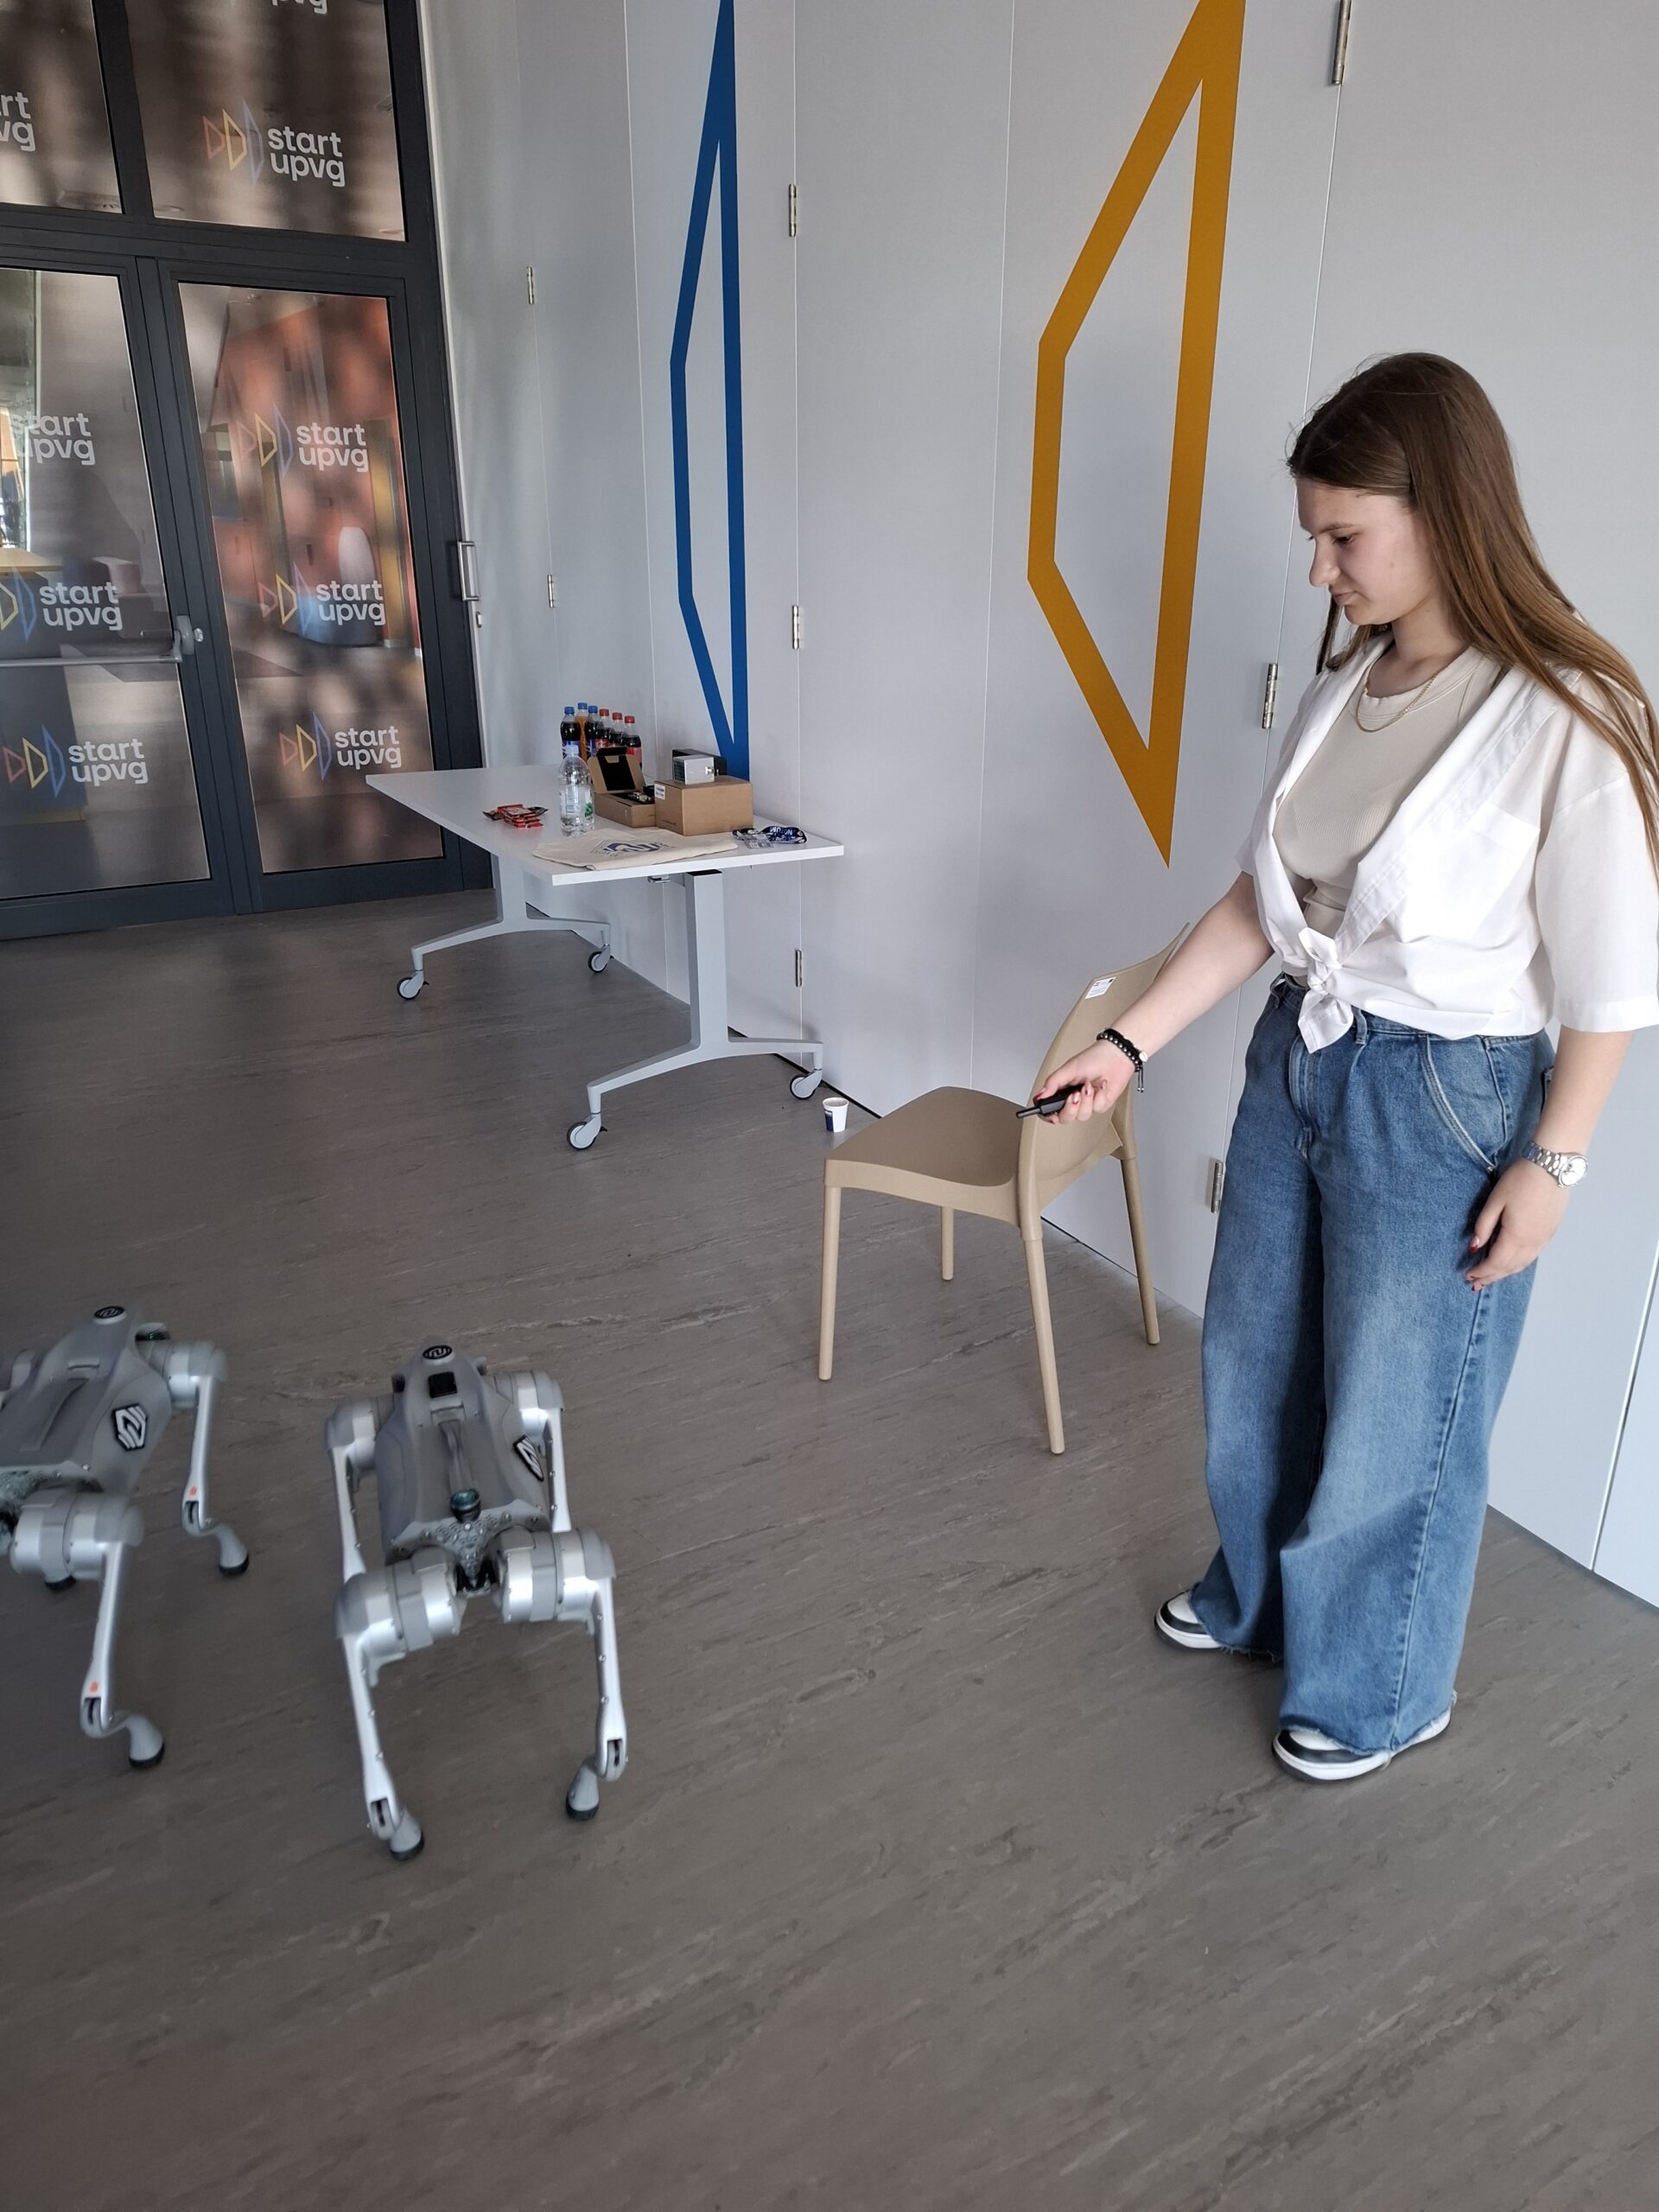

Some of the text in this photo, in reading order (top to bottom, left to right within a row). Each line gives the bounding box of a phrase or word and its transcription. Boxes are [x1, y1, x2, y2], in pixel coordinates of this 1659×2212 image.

[0, 92, 31, 119] rt
[267, 125, 343, 157] start
[270, 152, 346, 188] upvg
[11, 411, 92, 436] start
[296, 422, 366, 446] start
[298, 447, 369, 473] upvg
[39, 582, 119, 605] start
[316, 580, 384, 601] start
[42, 607, 123, 631] upvg
[318, 602, 386, 626] upvg
[334, 726, 400, 748] start
[67, 739, 145, 763] start
[336, 747, 402, 770] upvg
[71, 761, 149, 787] upvg
